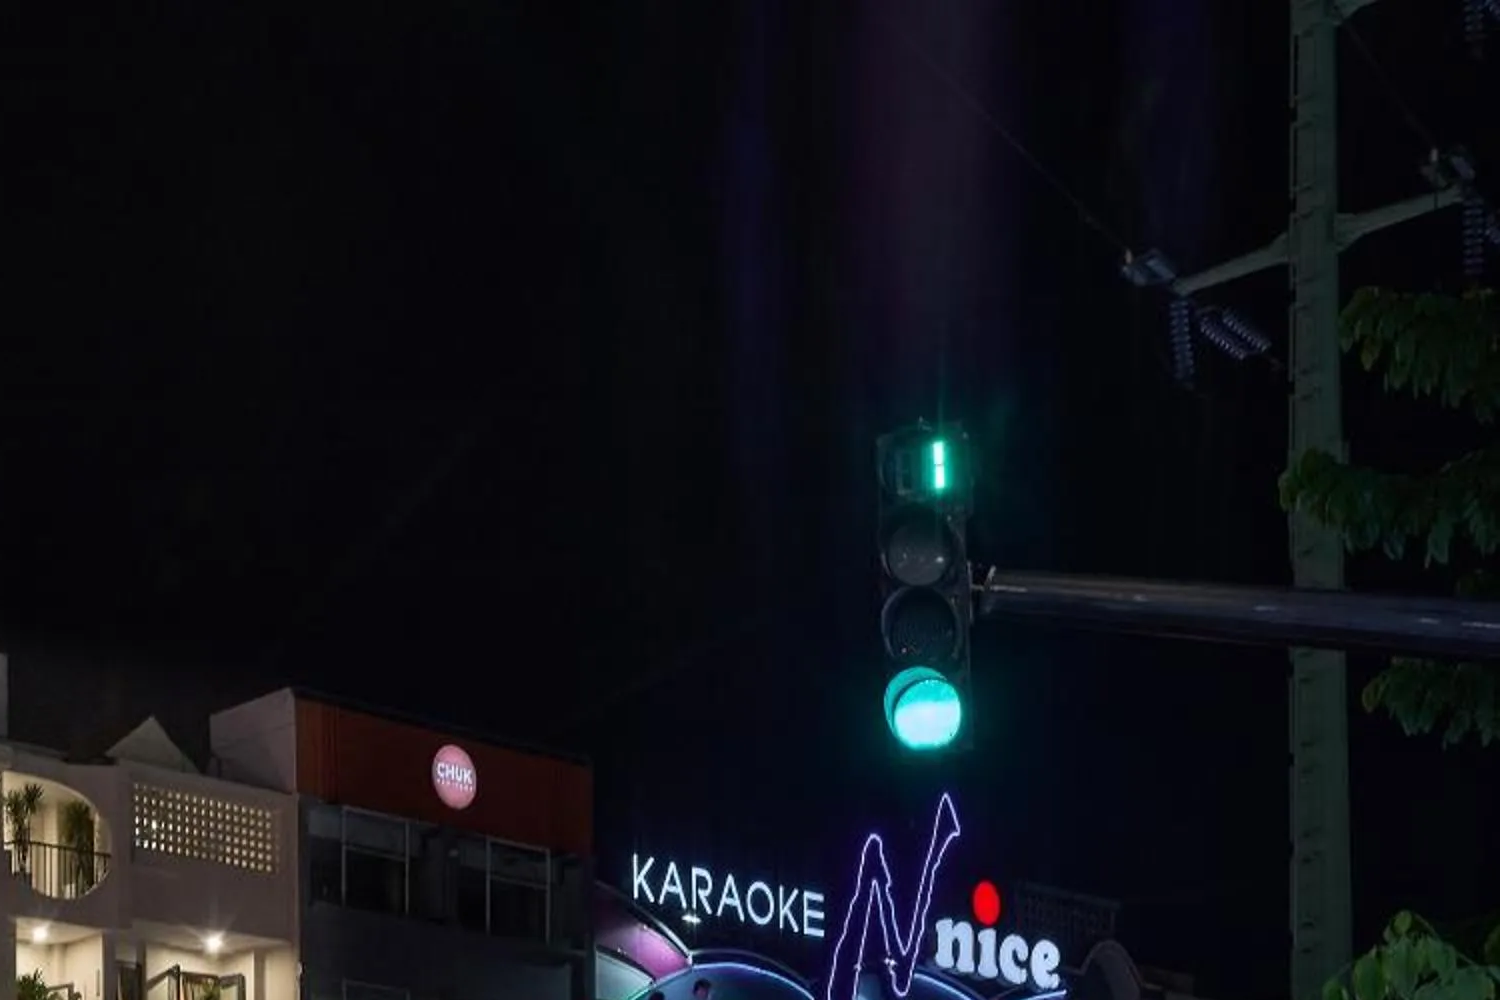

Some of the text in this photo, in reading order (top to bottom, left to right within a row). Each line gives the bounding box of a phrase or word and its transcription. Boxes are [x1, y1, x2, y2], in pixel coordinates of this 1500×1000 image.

[437, 762, 473, 785] CHUK
[632, 853, 825, 938] KARAOKE
[935, 880, 1061, 989] nice
